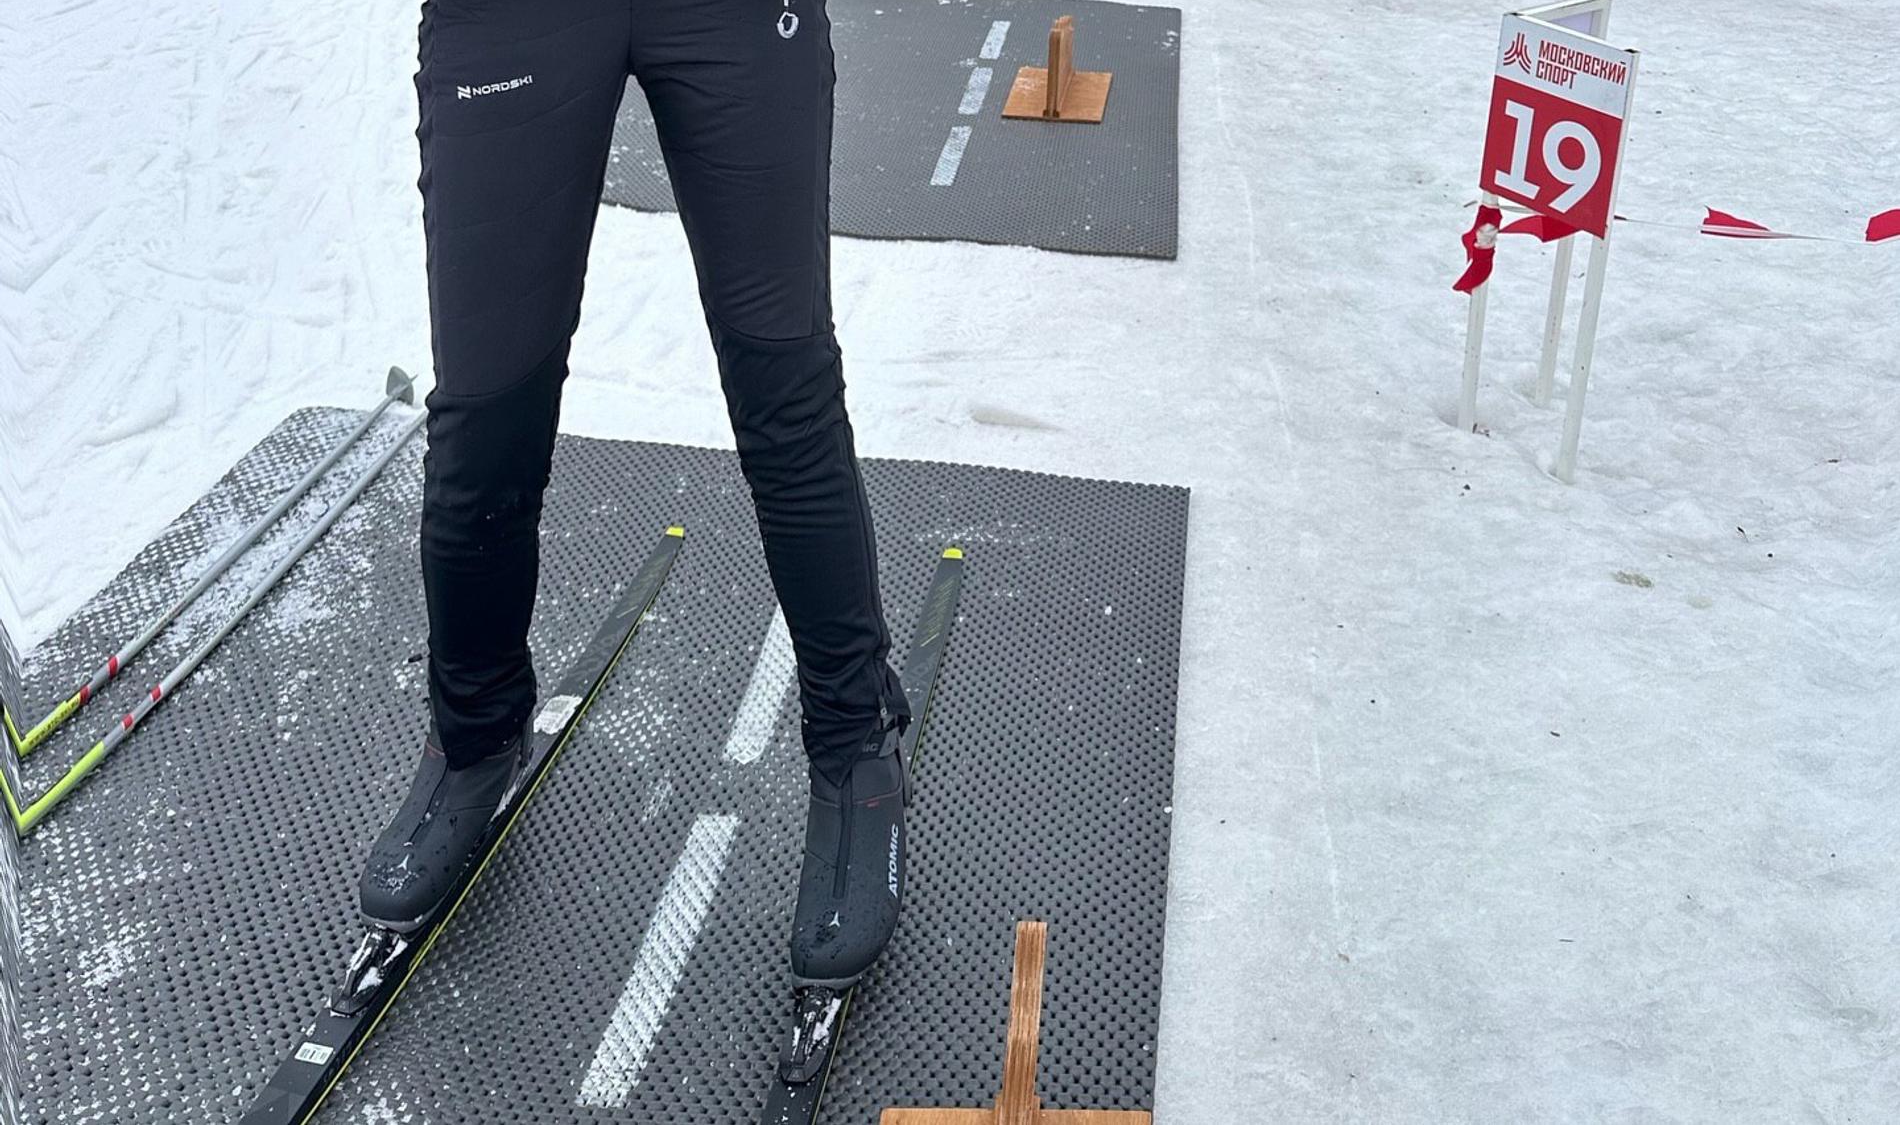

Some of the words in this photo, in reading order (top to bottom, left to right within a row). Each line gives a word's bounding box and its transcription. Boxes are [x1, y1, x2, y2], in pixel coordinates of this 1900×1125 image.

[472, 75, 533, 96] NORDSKI
[1535, 60, 1578, 89] СПОРТ
[1538, 40, 1627, 86] МОСКОВСКИЙ
[1494, 98, 1602, 214] 19
[888, 823, 899, 898] ATOMIC
